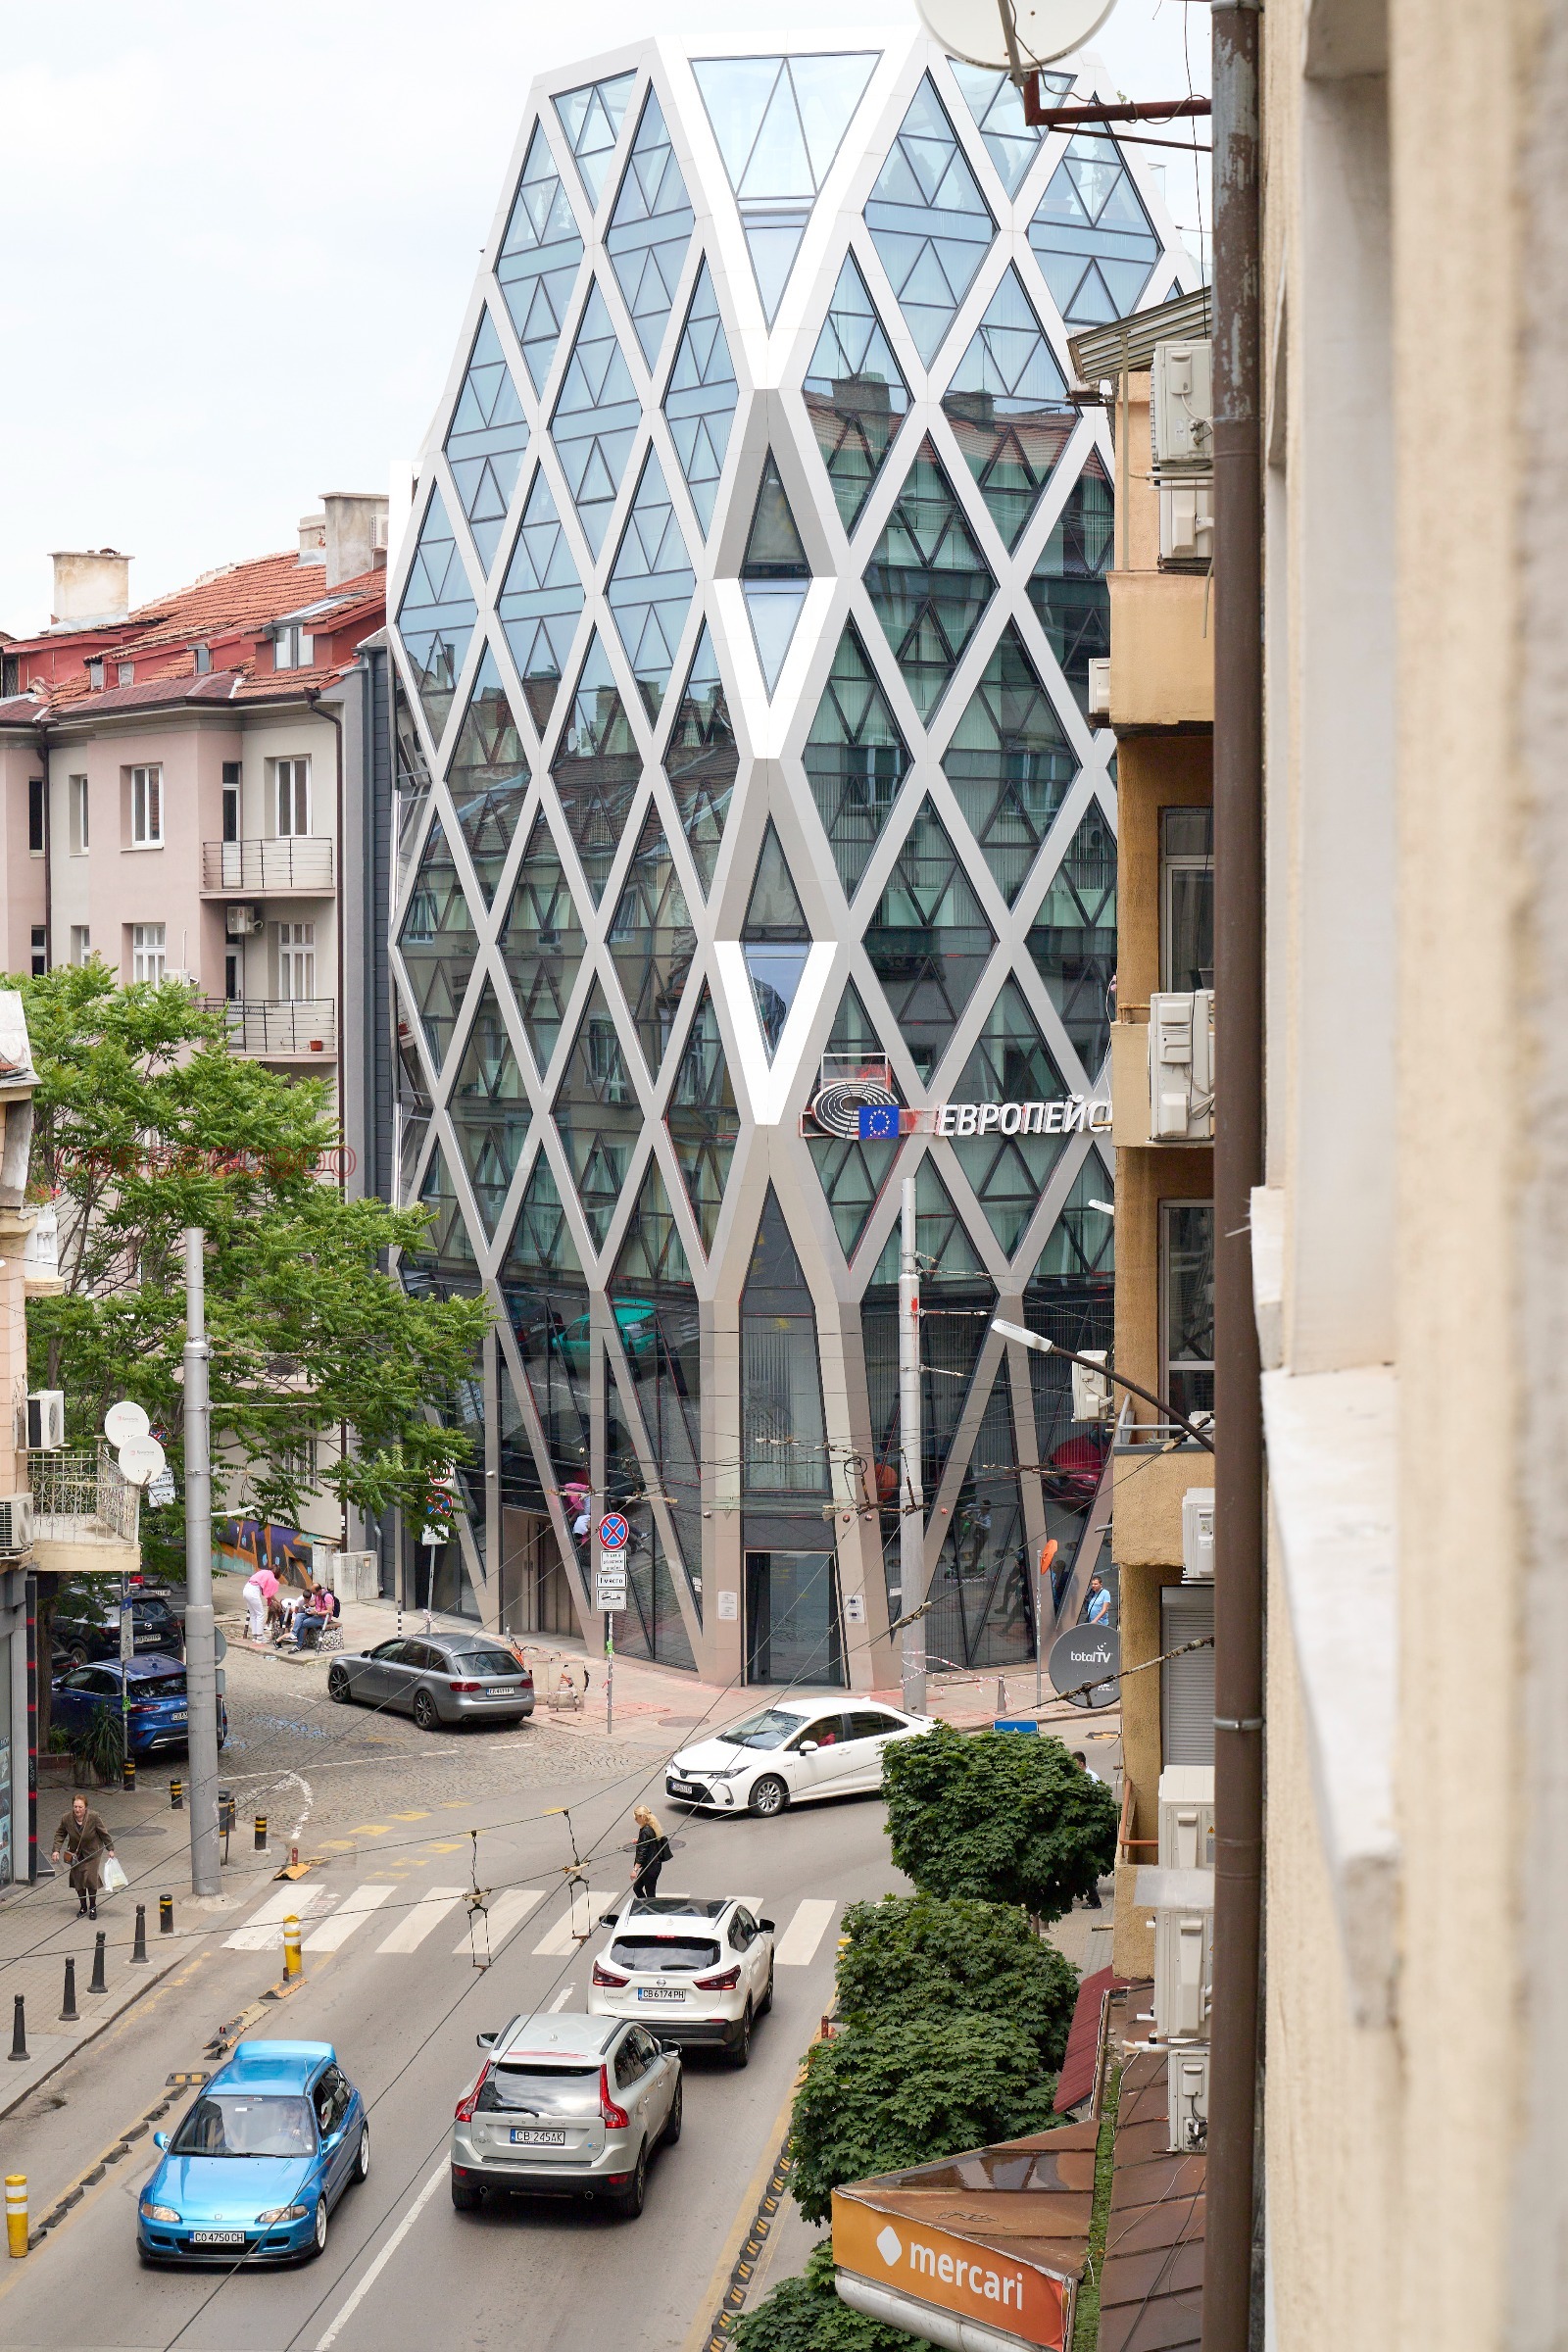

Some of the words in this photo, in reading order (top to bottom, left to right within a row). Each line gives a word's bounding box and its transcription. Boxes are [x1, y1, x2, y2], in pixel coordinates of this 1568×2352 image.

[1070, 1650, 1111, 1663] totalTV
[643, 1989, 654, 1998] CB
[673, 1990, 684, 1999] PH
[209, 2232, 230, 2242] 4750
[231, 2232, 244, 2242] CH
[909, 2241, 1023, 2311] mercari
